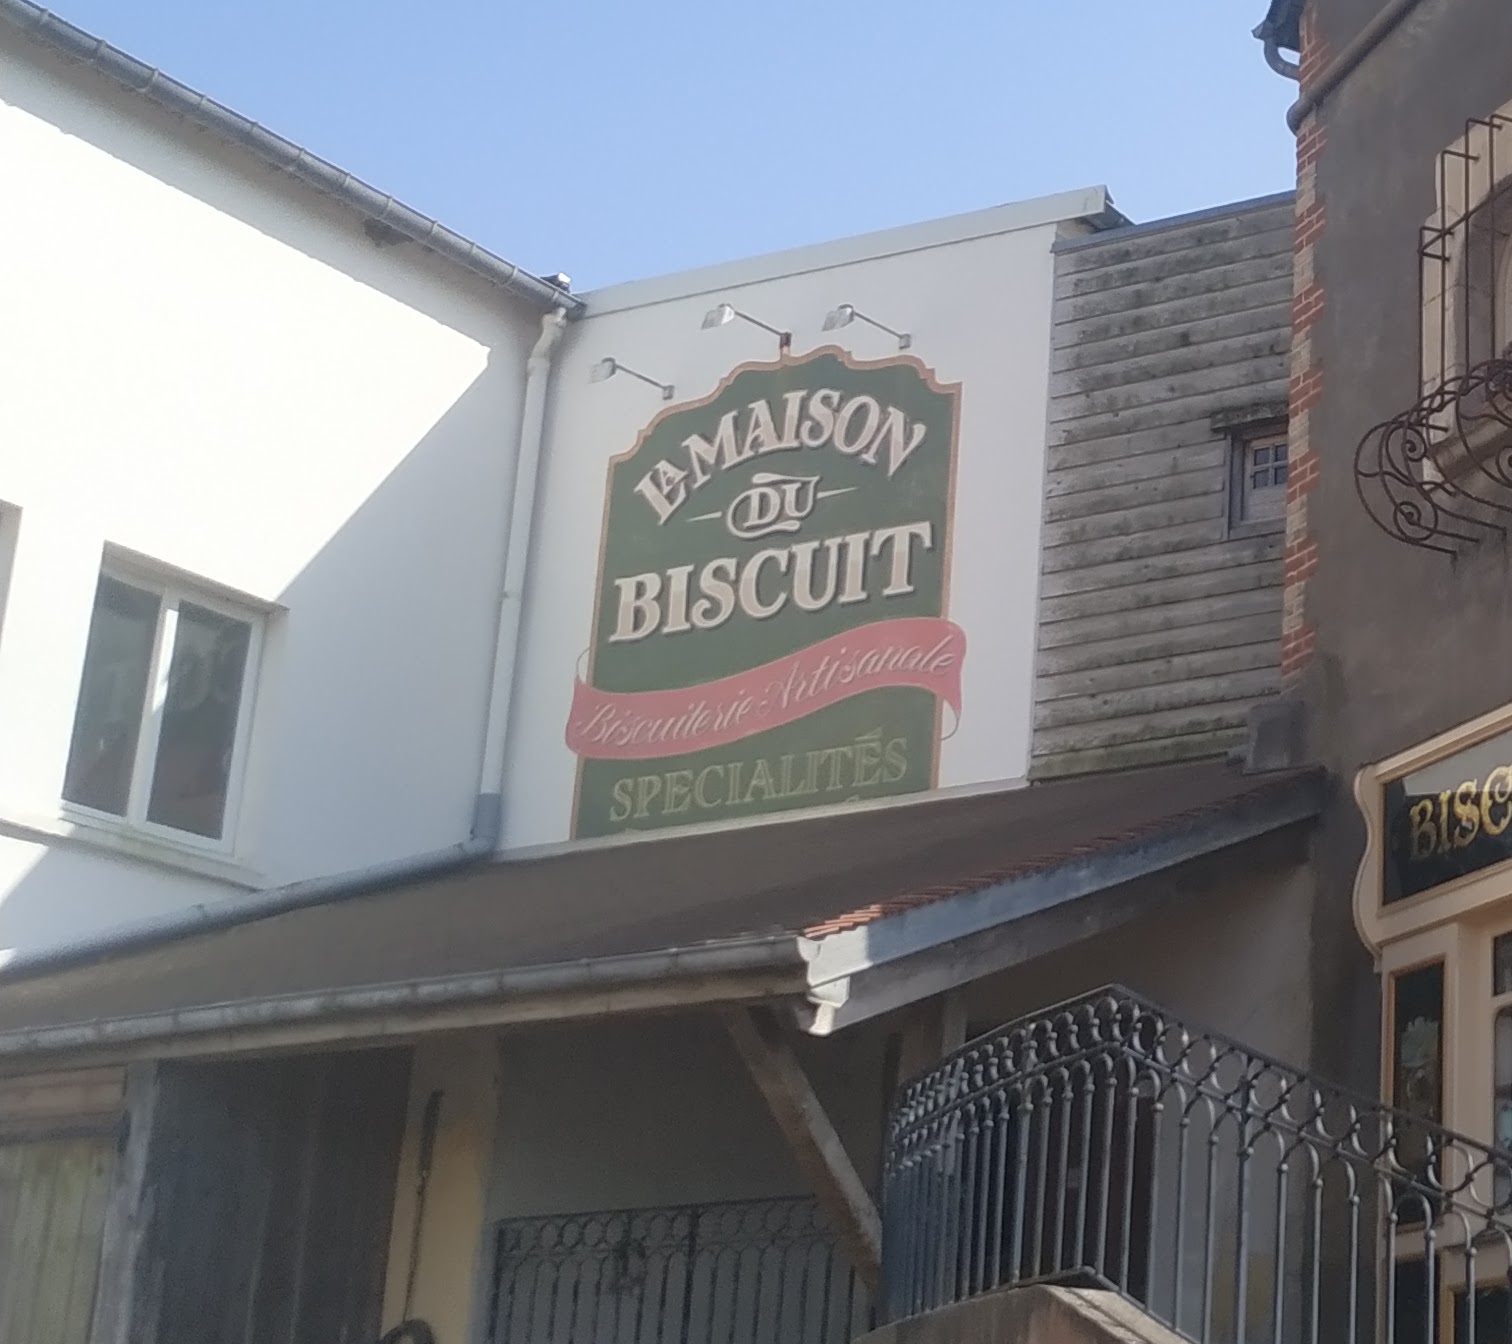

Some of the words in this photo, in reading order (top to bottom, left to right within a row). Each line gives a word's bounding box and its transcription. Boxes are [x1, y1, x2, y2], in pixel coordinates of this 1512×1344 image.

[634, 459, 690, 525] LA
[681, 387, 927, 477] MAISON
[733, 472, 822, 534] DU
[609, 521, 932, 643] BISCUIT
[575, 687, 754, 746] Biscuiterie
[759, 635, 955, 711] Artisanale
[608, 724, 909, 823] SPECIALITÉS
